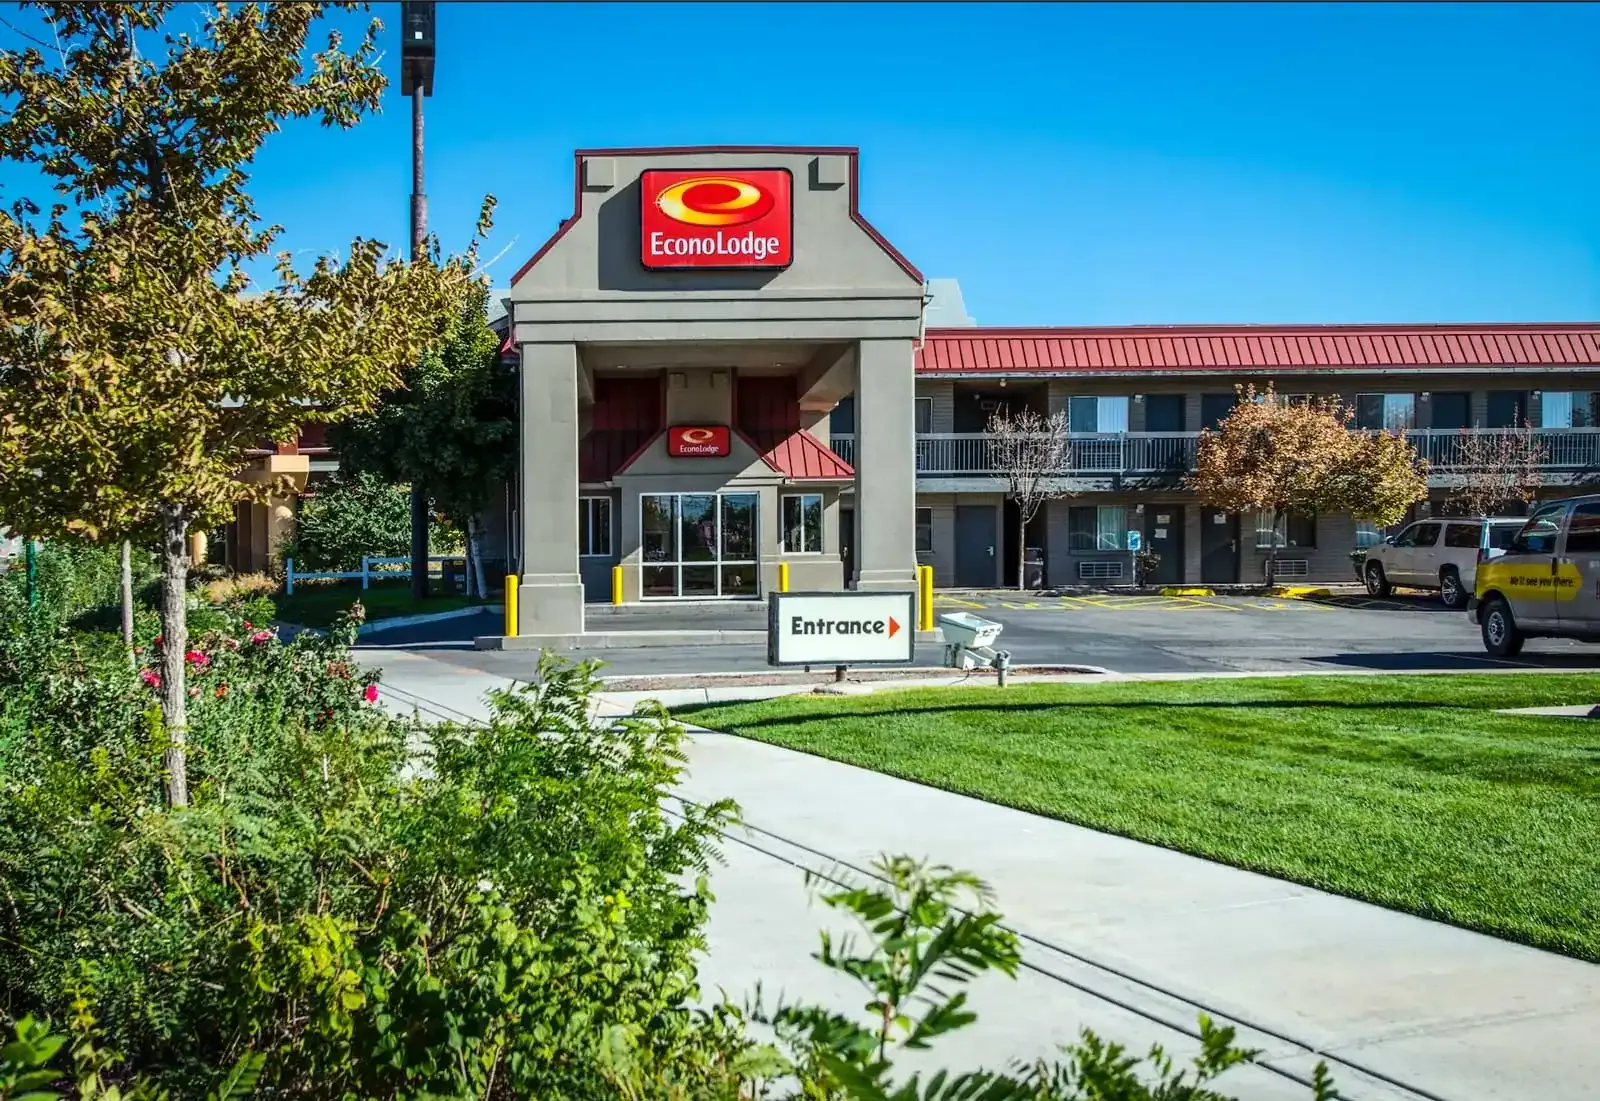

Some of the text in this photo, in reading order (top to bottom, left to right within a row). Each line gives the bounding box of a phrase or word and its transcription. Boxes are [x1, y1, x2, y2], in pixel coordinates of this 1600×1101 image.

[651, 231, 779, 260] EconoLodge
[680, 444, 719, 454] EconoLodge
[792, 616, 885, 635] Entrance
